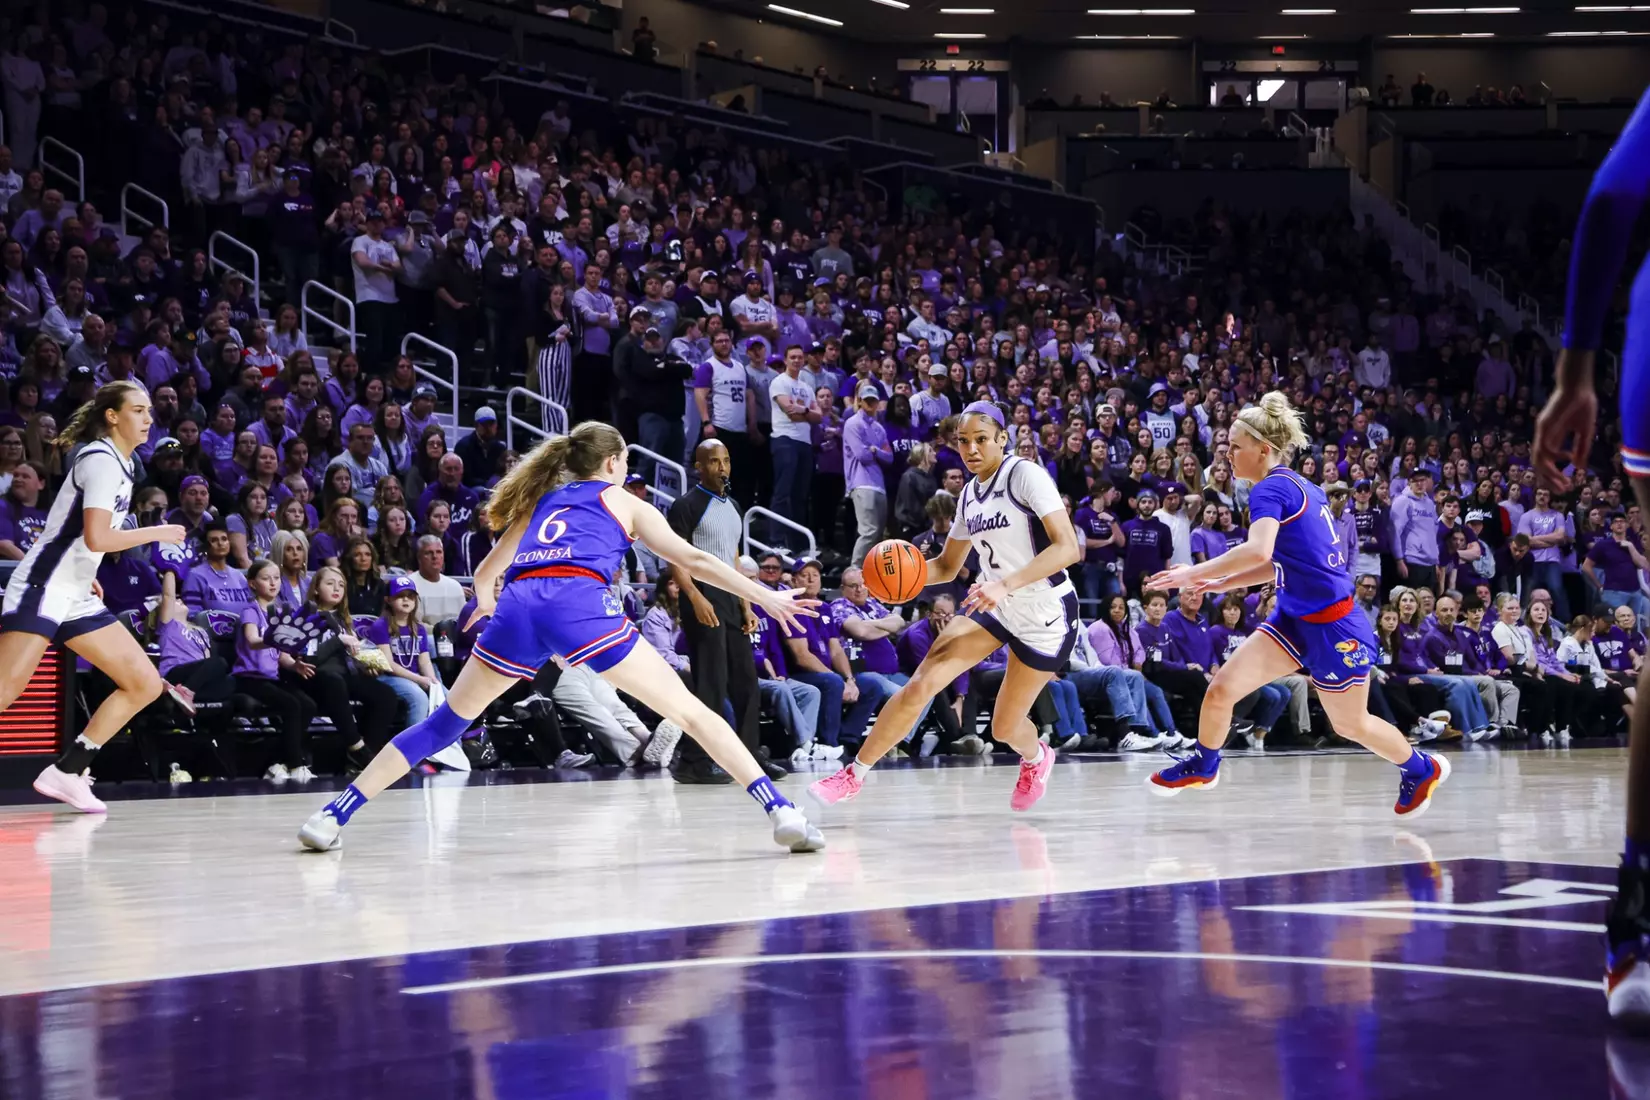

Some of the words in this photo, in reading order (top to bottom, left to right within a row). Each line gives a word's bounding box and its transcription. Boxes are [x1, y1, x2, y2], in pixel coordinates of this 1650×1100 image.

[920, 60, 937, 70] 22
[968, 60, 985, 70] 22
[731, 387, 744, 403] 25
[1153, 427, 1171, 439] 50
[660, 474, 677, 490] WE
[537, 507, 571, 544] 6
[966, 511, 1011, 536] Wildcats
[513, 546, 573, 564] CONESA
[882, 544, 896, 576] ELITE
[980, 539, 1001, 569] 2
